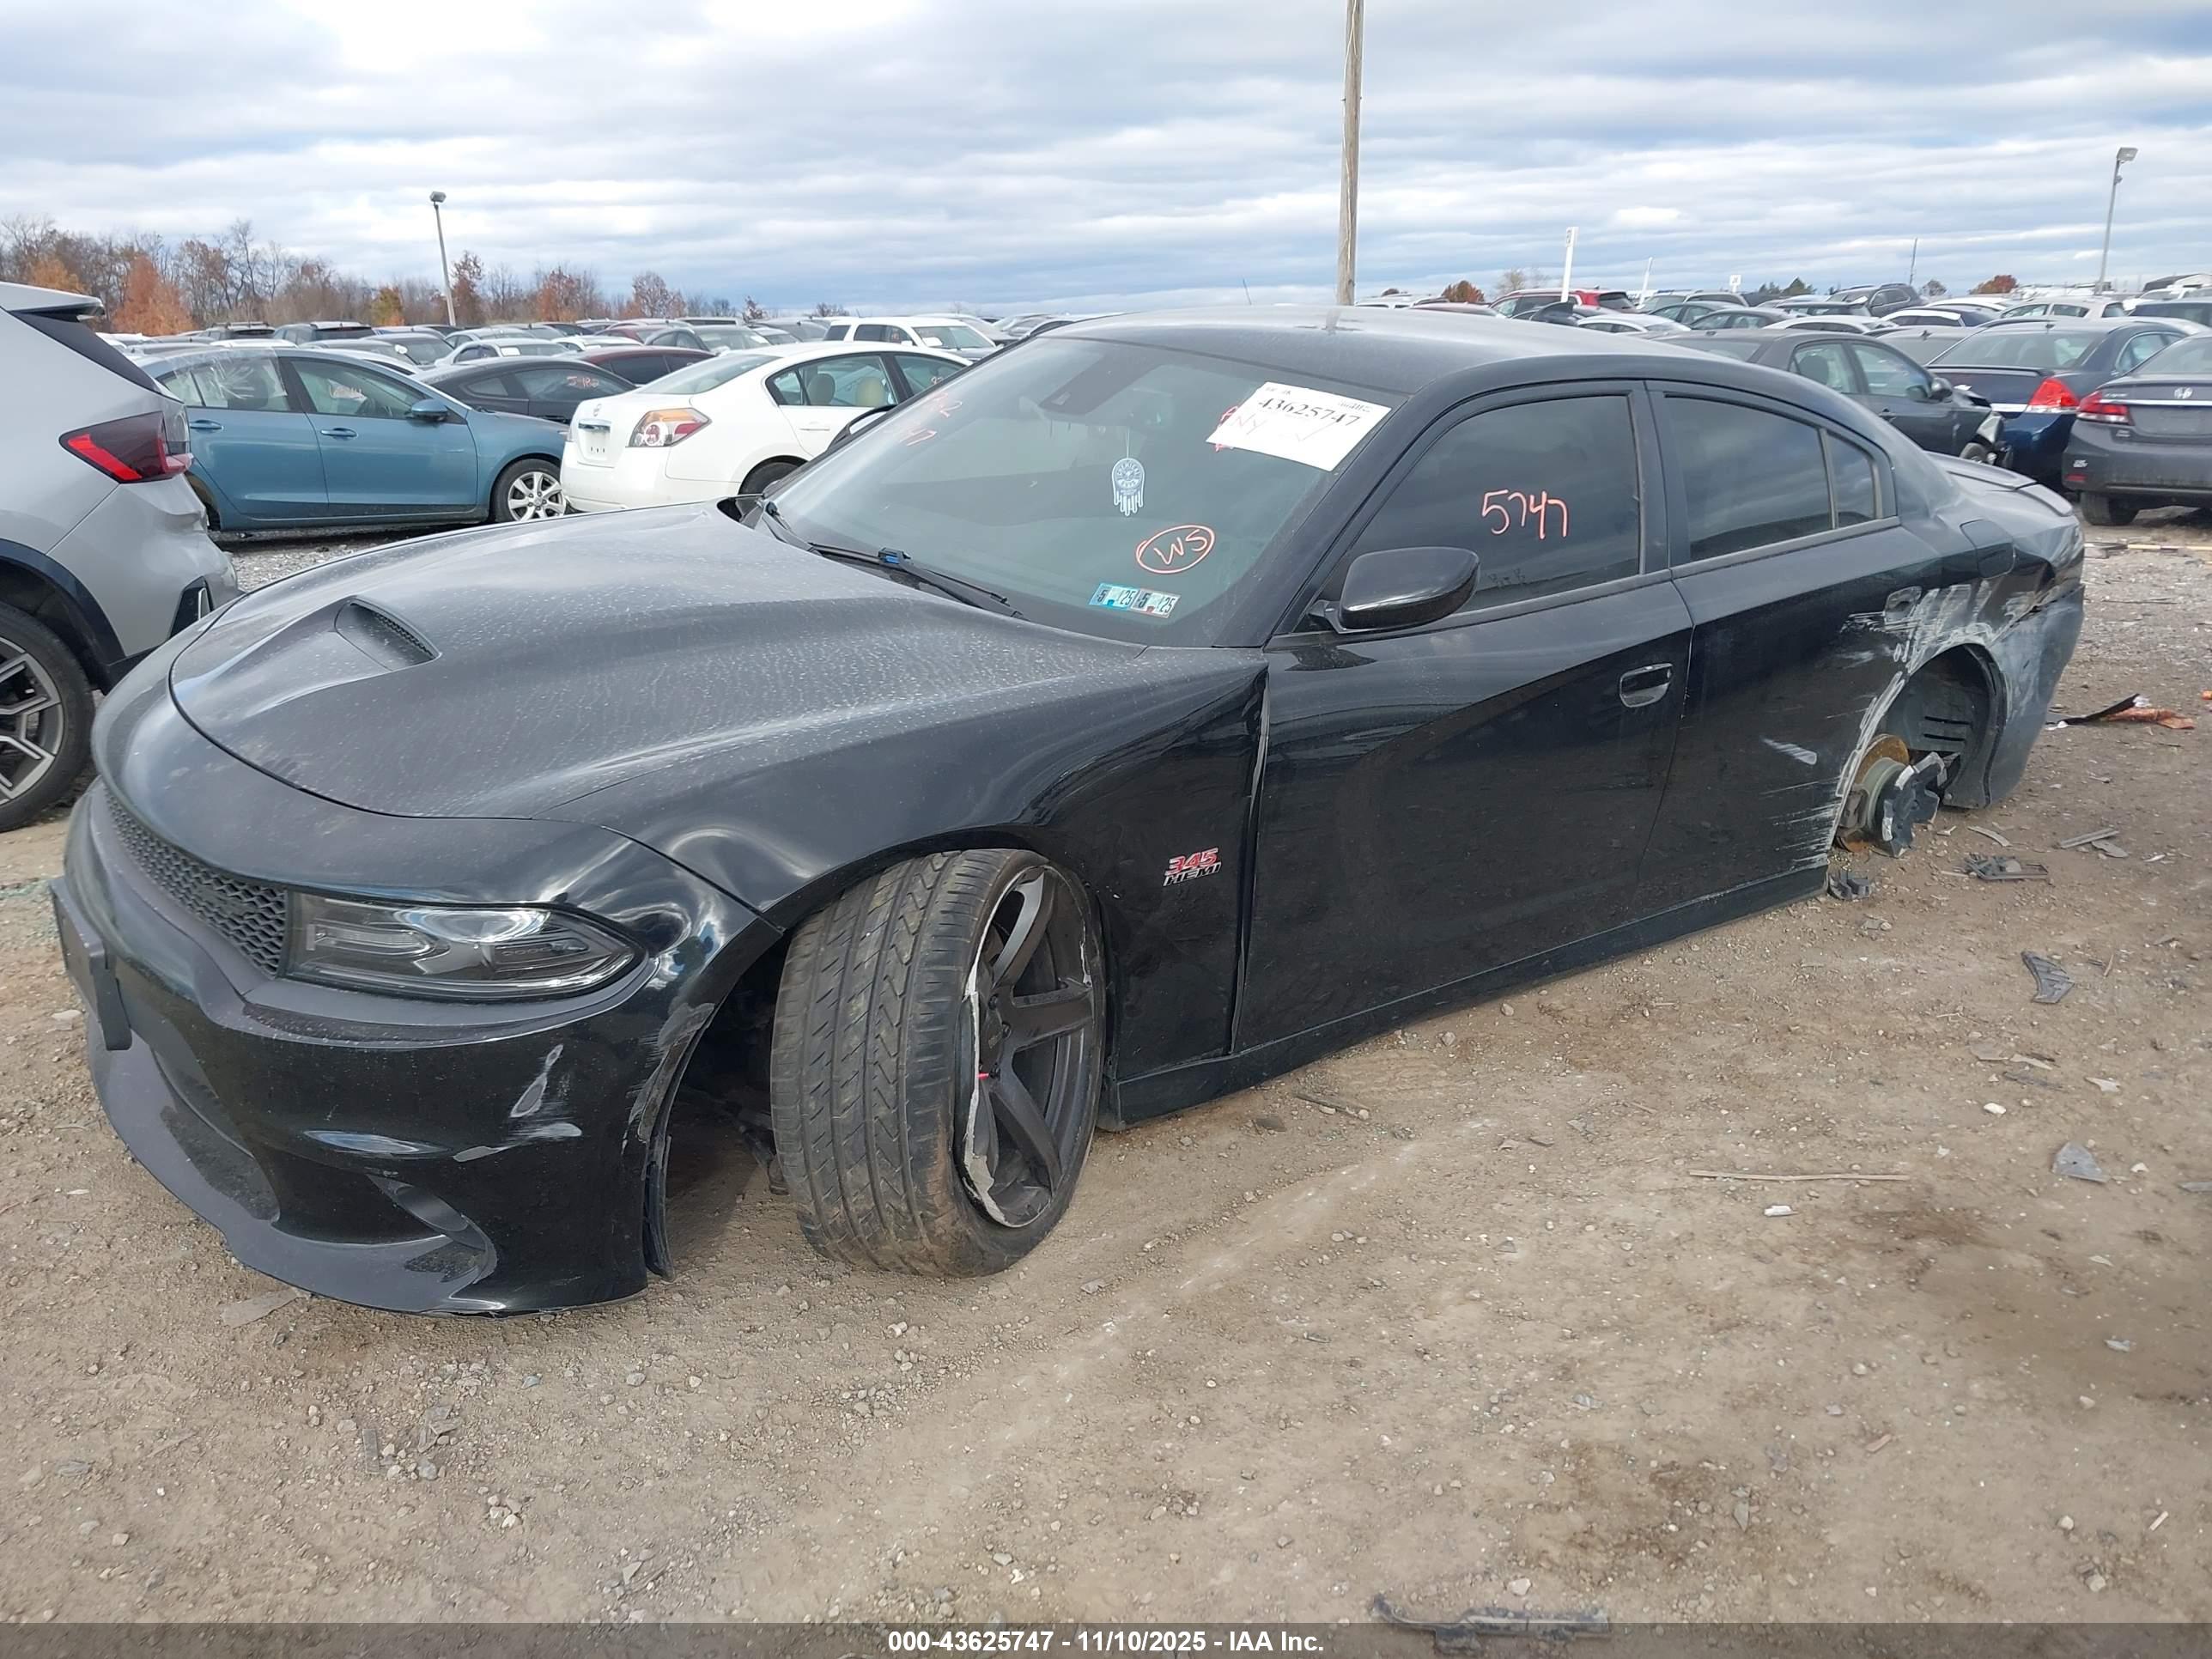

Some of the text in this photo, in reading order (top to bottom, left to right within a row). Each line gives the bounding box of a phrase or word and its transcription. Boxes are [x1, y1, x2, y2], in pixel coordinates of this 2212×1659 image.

[1258, 398, 1361, 426] 43625747
[1481, 489, 1568, 539] 5747
[1153, 528, 1208, 565] WS
[1120, 590, 1136, 605] 25
[1160, 597, 1176, 613] 25
[1162, 861, 1222, 887] HEMI
[1164, 847, 1219, 876] 345
